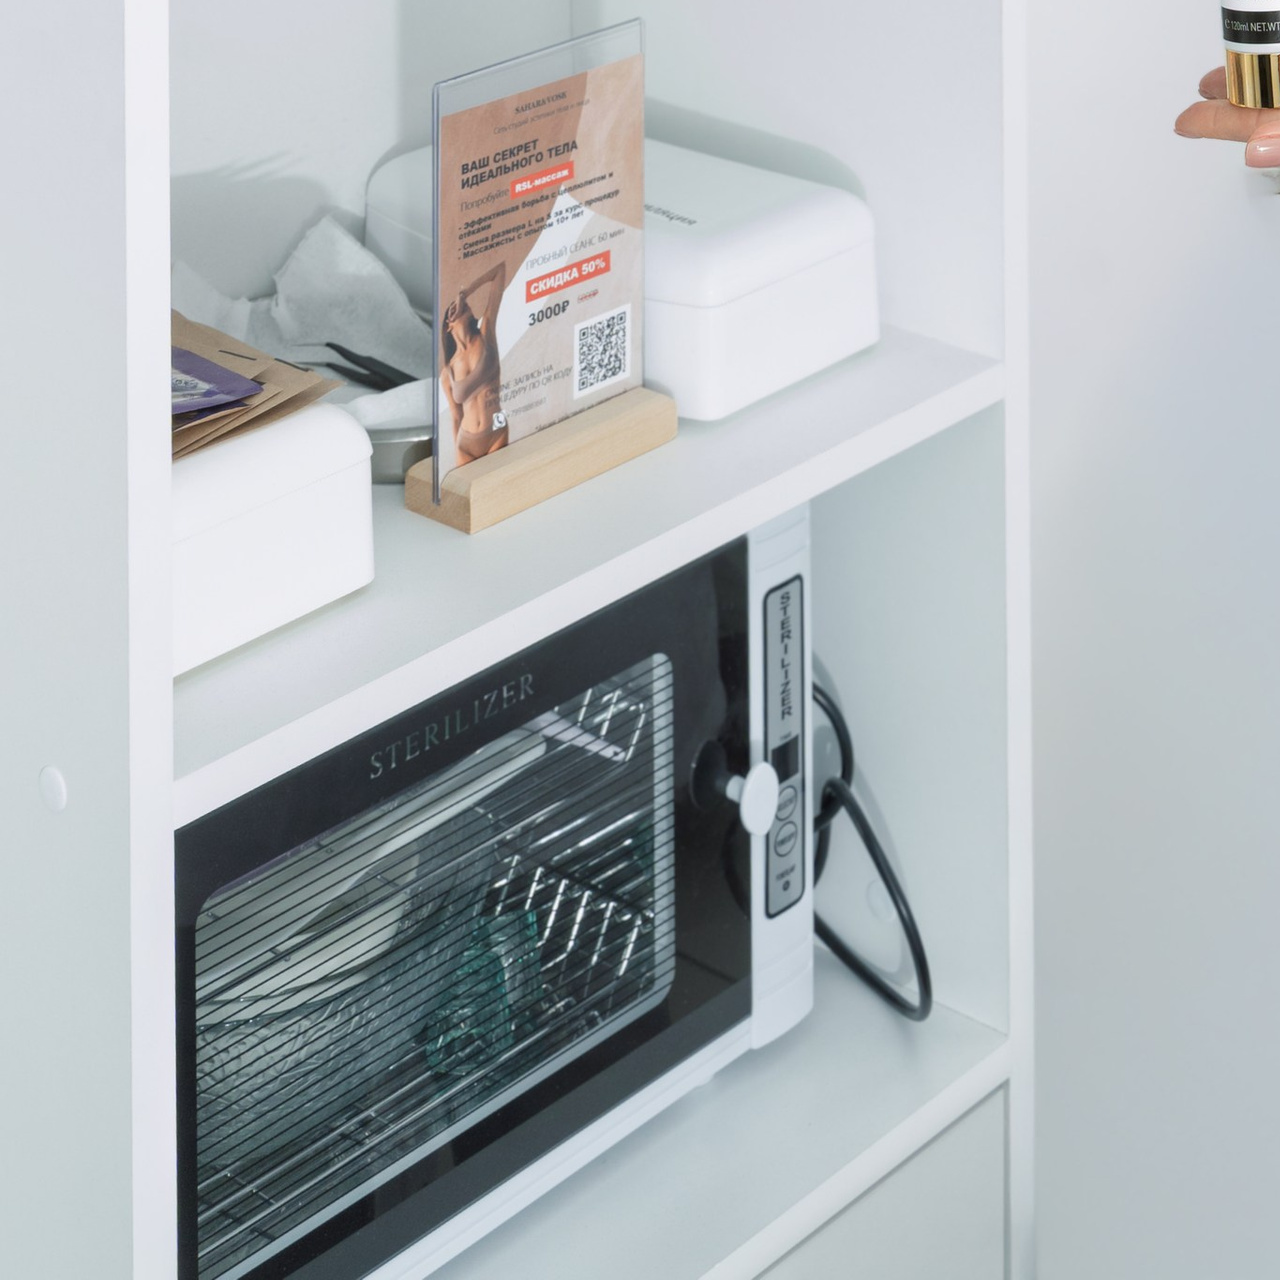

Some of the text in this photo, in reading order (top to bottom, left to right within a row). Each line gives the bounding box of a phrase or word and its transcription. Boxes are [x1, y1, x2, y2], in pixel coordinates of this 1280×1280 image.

[1230, 20, 1249, 32] 120ml
[460, 139, 579, 190] ИДЕАЛЬНОГО ТЕЛА
[461, 138, 540, 176] ВАШ СЕКРЕТ
[460, 167, 570, 212] Попробуйте RSL-массаж
[463, 174, 608, 231] Эффективная борьба целлюлитом
[462, 210, 584, 261] Массажисты опытом 10+ лет
[463, 188, 620, 252] Смена размера курс процедур
[526, 227, 625, 271] ПРОБНЫЙ СЕАНС 60 мин
[530, 256, 606, 296] СКИДКА 50%
[513, 364, 554, 388] ЗАПИСЬ НА
[528, 380, 541, 391] ПО
[541, 374, 553, 387] QR
[553, 365, 574, 382] КОДУ
[780, 591, 793, 721] STERILIZER
[370, 673, 536, 780] STERILIZER
